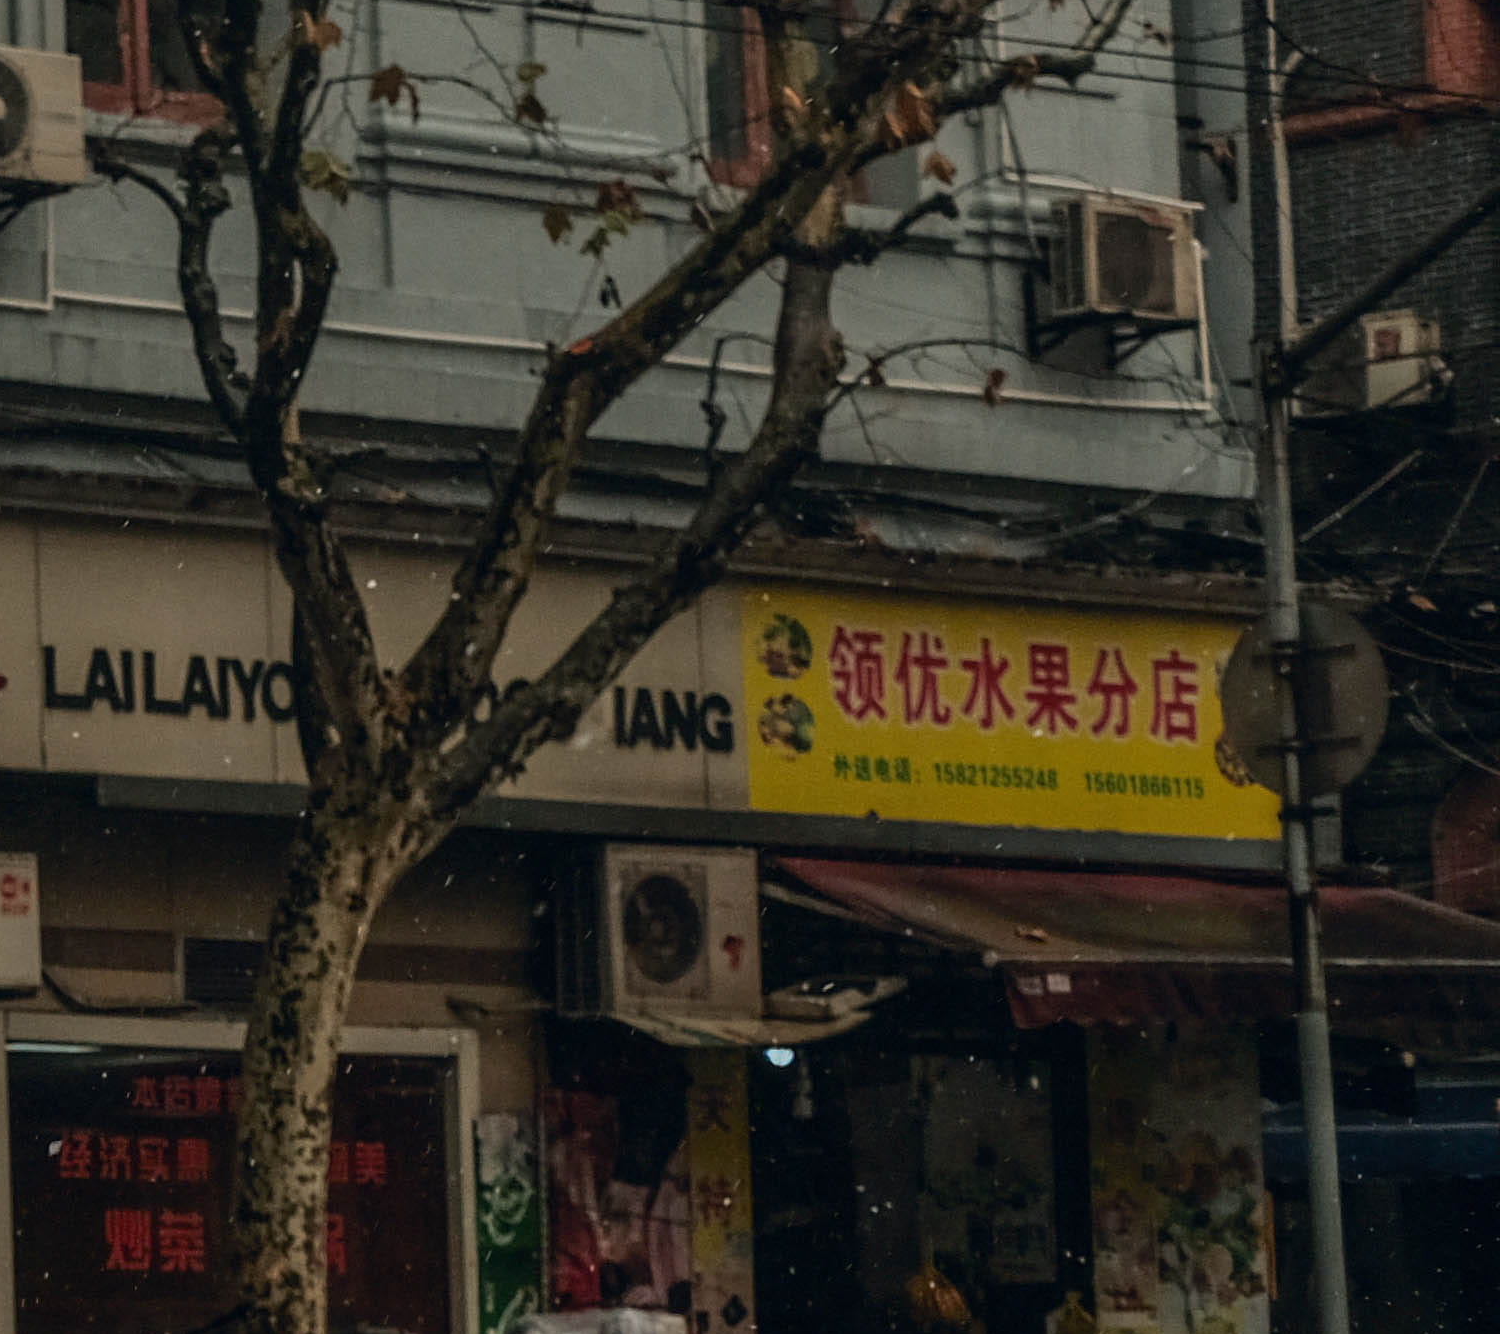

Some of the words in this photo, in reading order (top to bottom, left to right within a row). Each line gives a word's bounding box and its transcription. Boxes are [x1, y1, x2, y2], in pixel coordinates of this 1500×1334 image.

[827, 624, 1203, 744] 领优水果分店
[932, 761, 1058, 791] 15821255248
